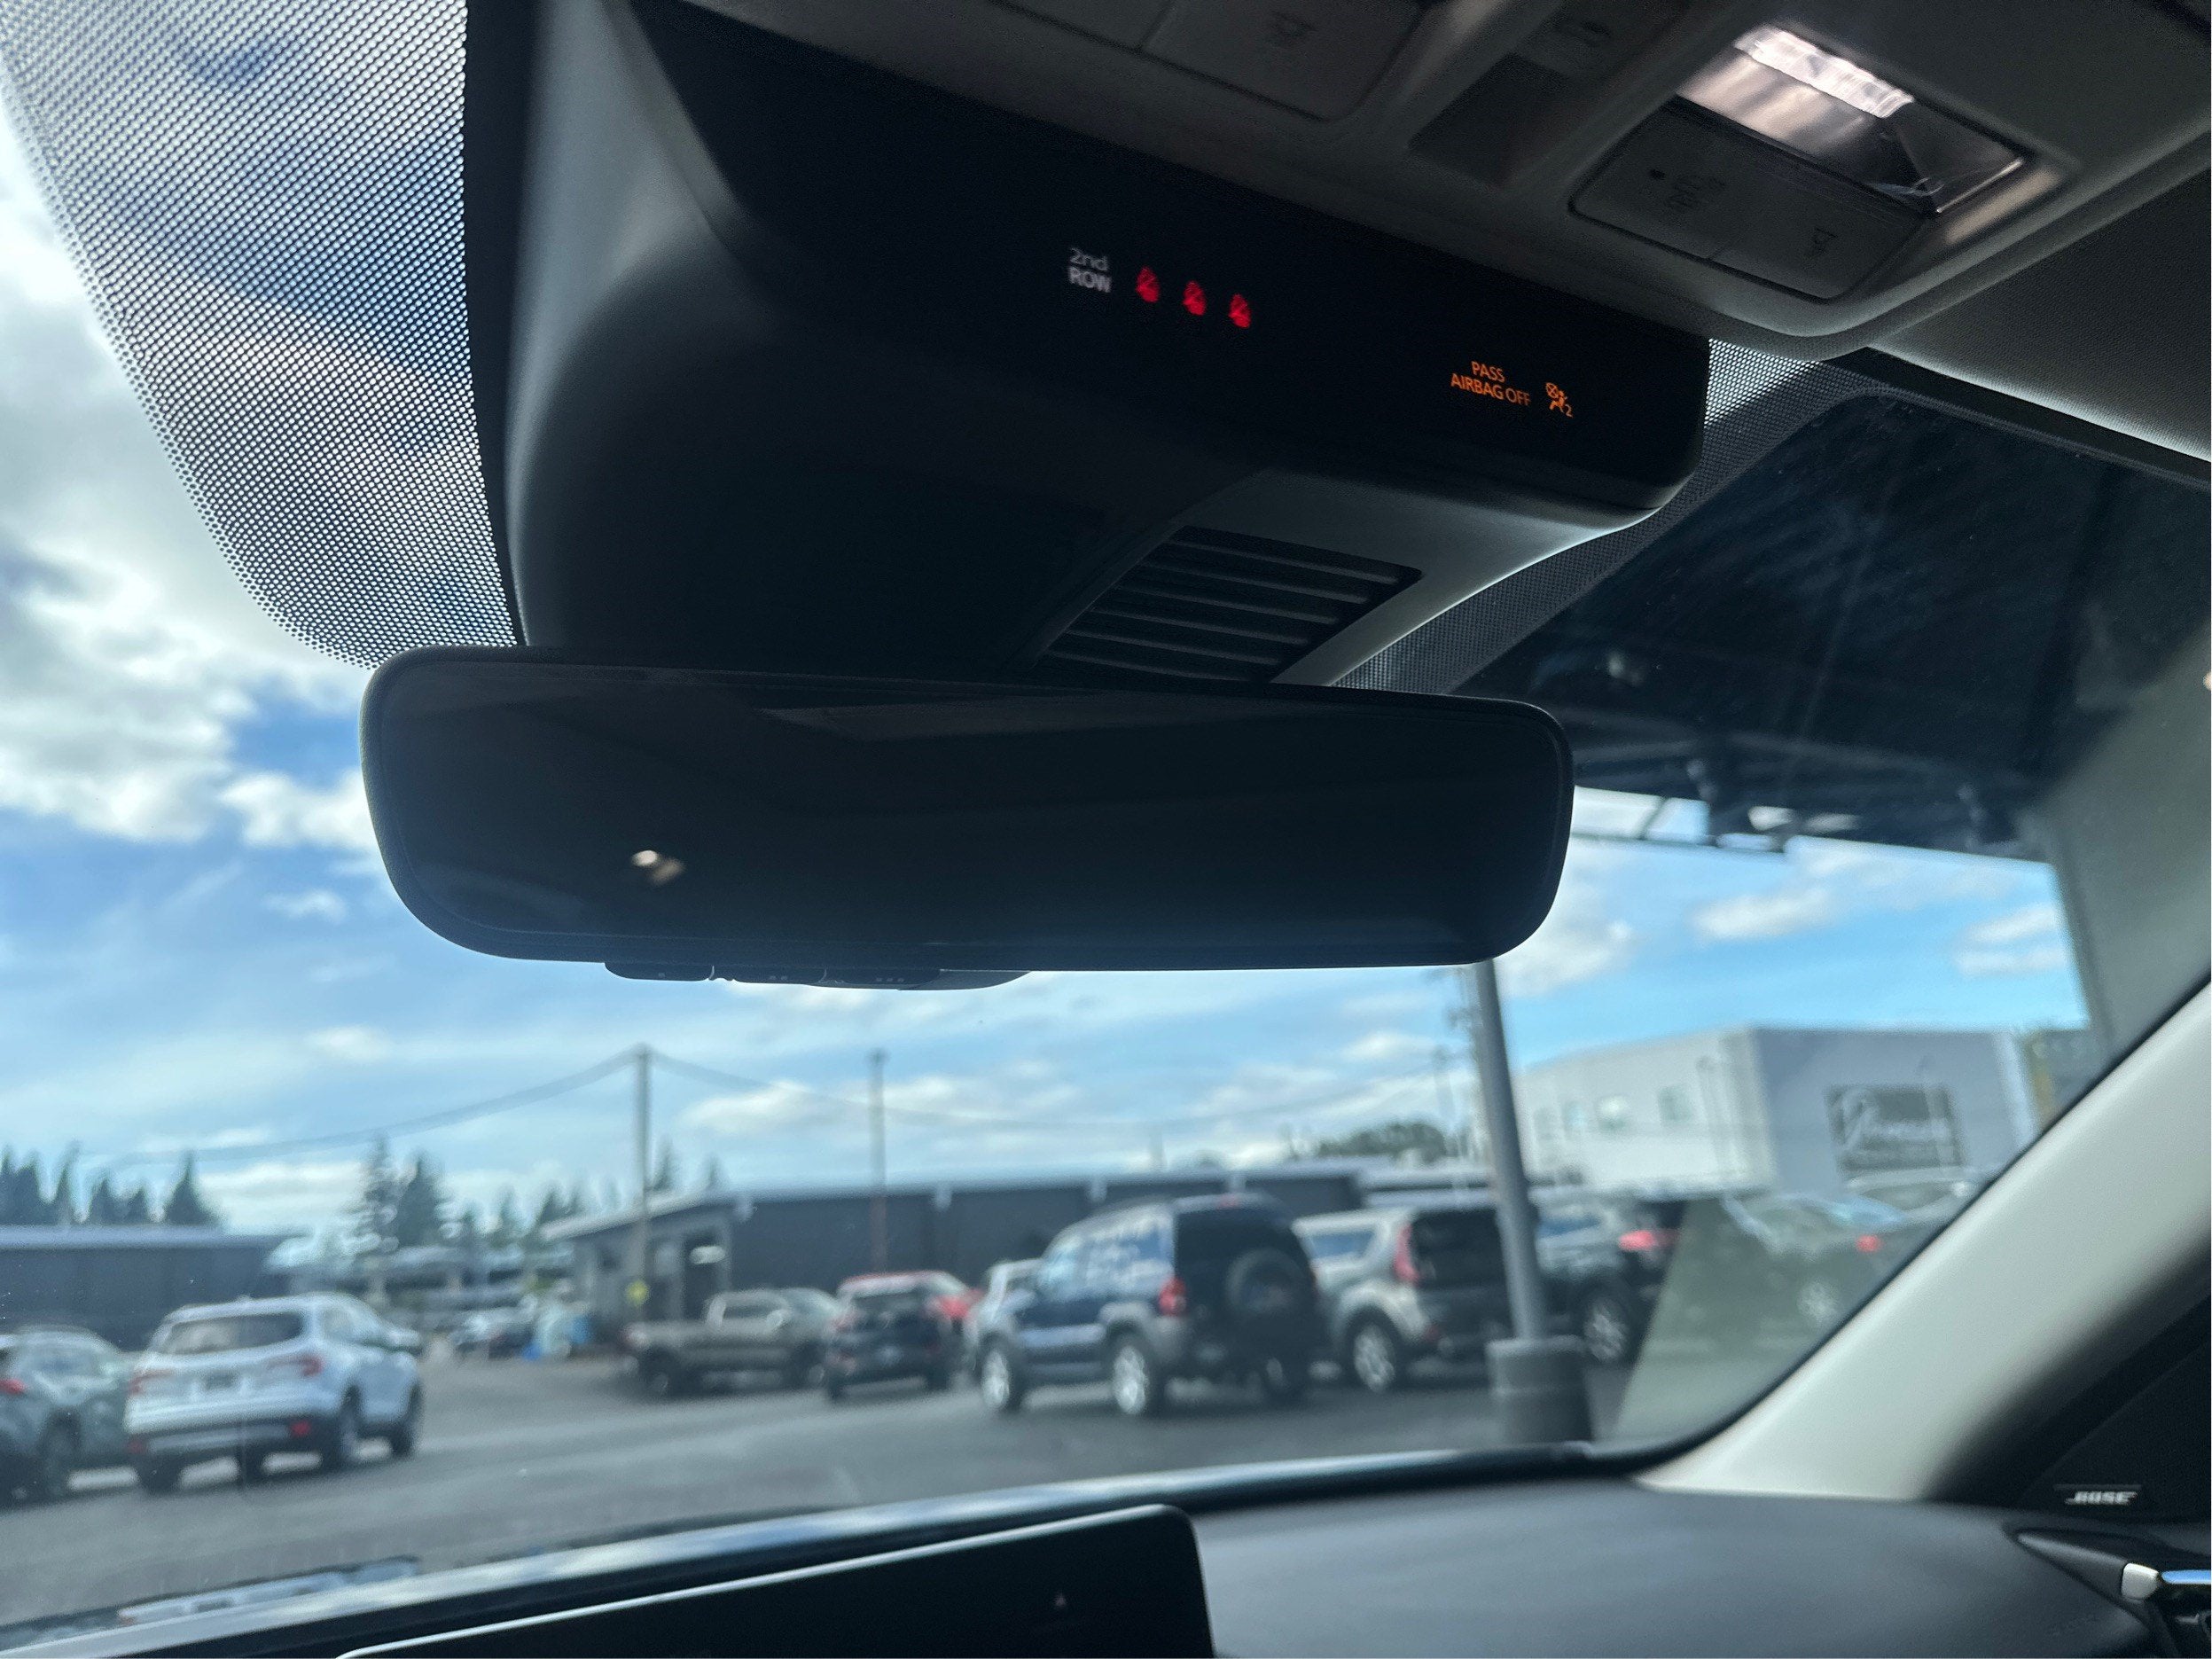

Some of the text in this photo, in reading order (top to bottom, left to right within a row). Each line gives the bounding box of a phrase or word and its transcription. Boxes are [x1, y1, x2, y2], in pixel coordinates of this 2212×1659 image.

[1069, 247, 1108, 270] 2nd
[1068, 266, 1112, 293] ROW
[1471, 361, 1505, 383] PASS
[1450, 373, 1531, 407] AIRBAG OFF
[2064, 1491, 2138, 1506] BOSE
